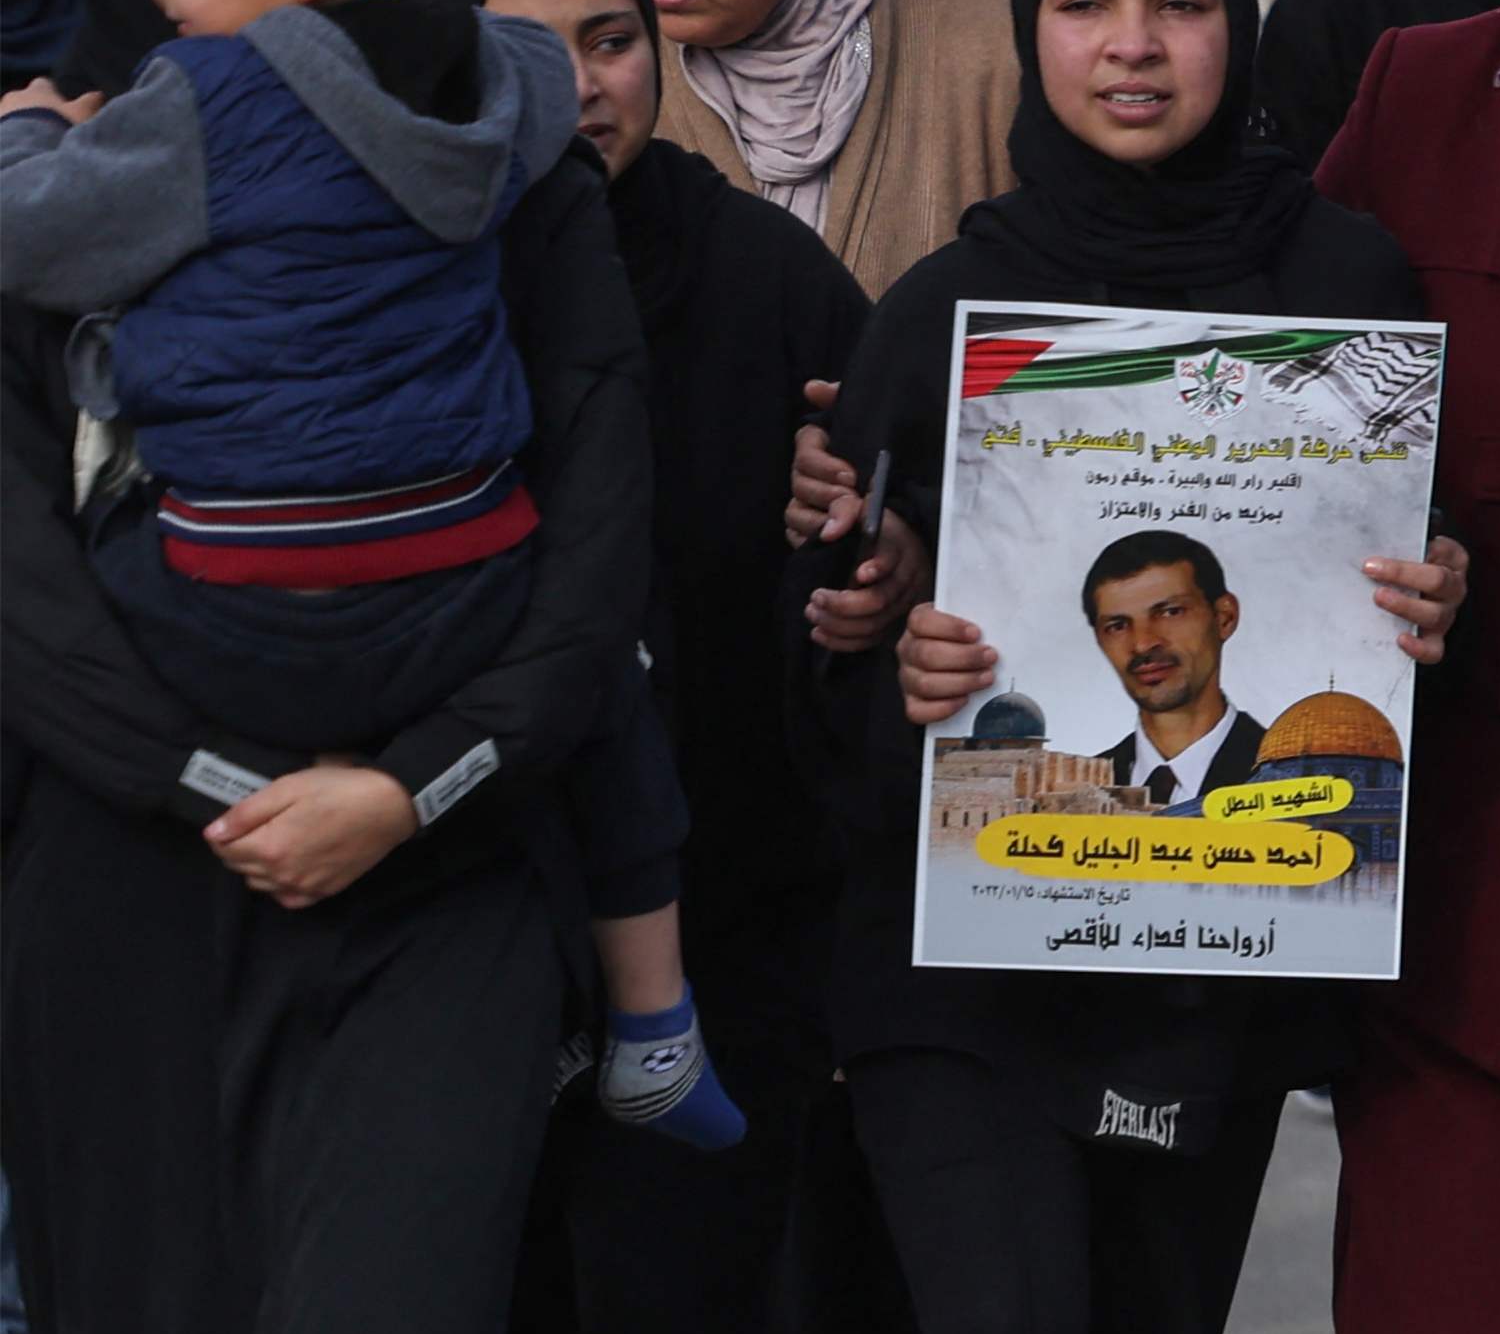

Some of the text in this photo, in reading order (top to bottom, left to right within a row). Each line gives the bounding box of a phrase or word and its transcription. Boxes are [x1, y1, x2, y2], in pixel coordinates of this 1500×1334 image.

[1220, 781, 1333, 818] الشهيد البطل
[1006, 830, 1322, 871] أحمد حسن عبد الجليل كحلة
[1045, 912, 1275, 959] أرواحنا فداء للأقصى
[1094, 1088, 1182, 1149] EVERLAST
